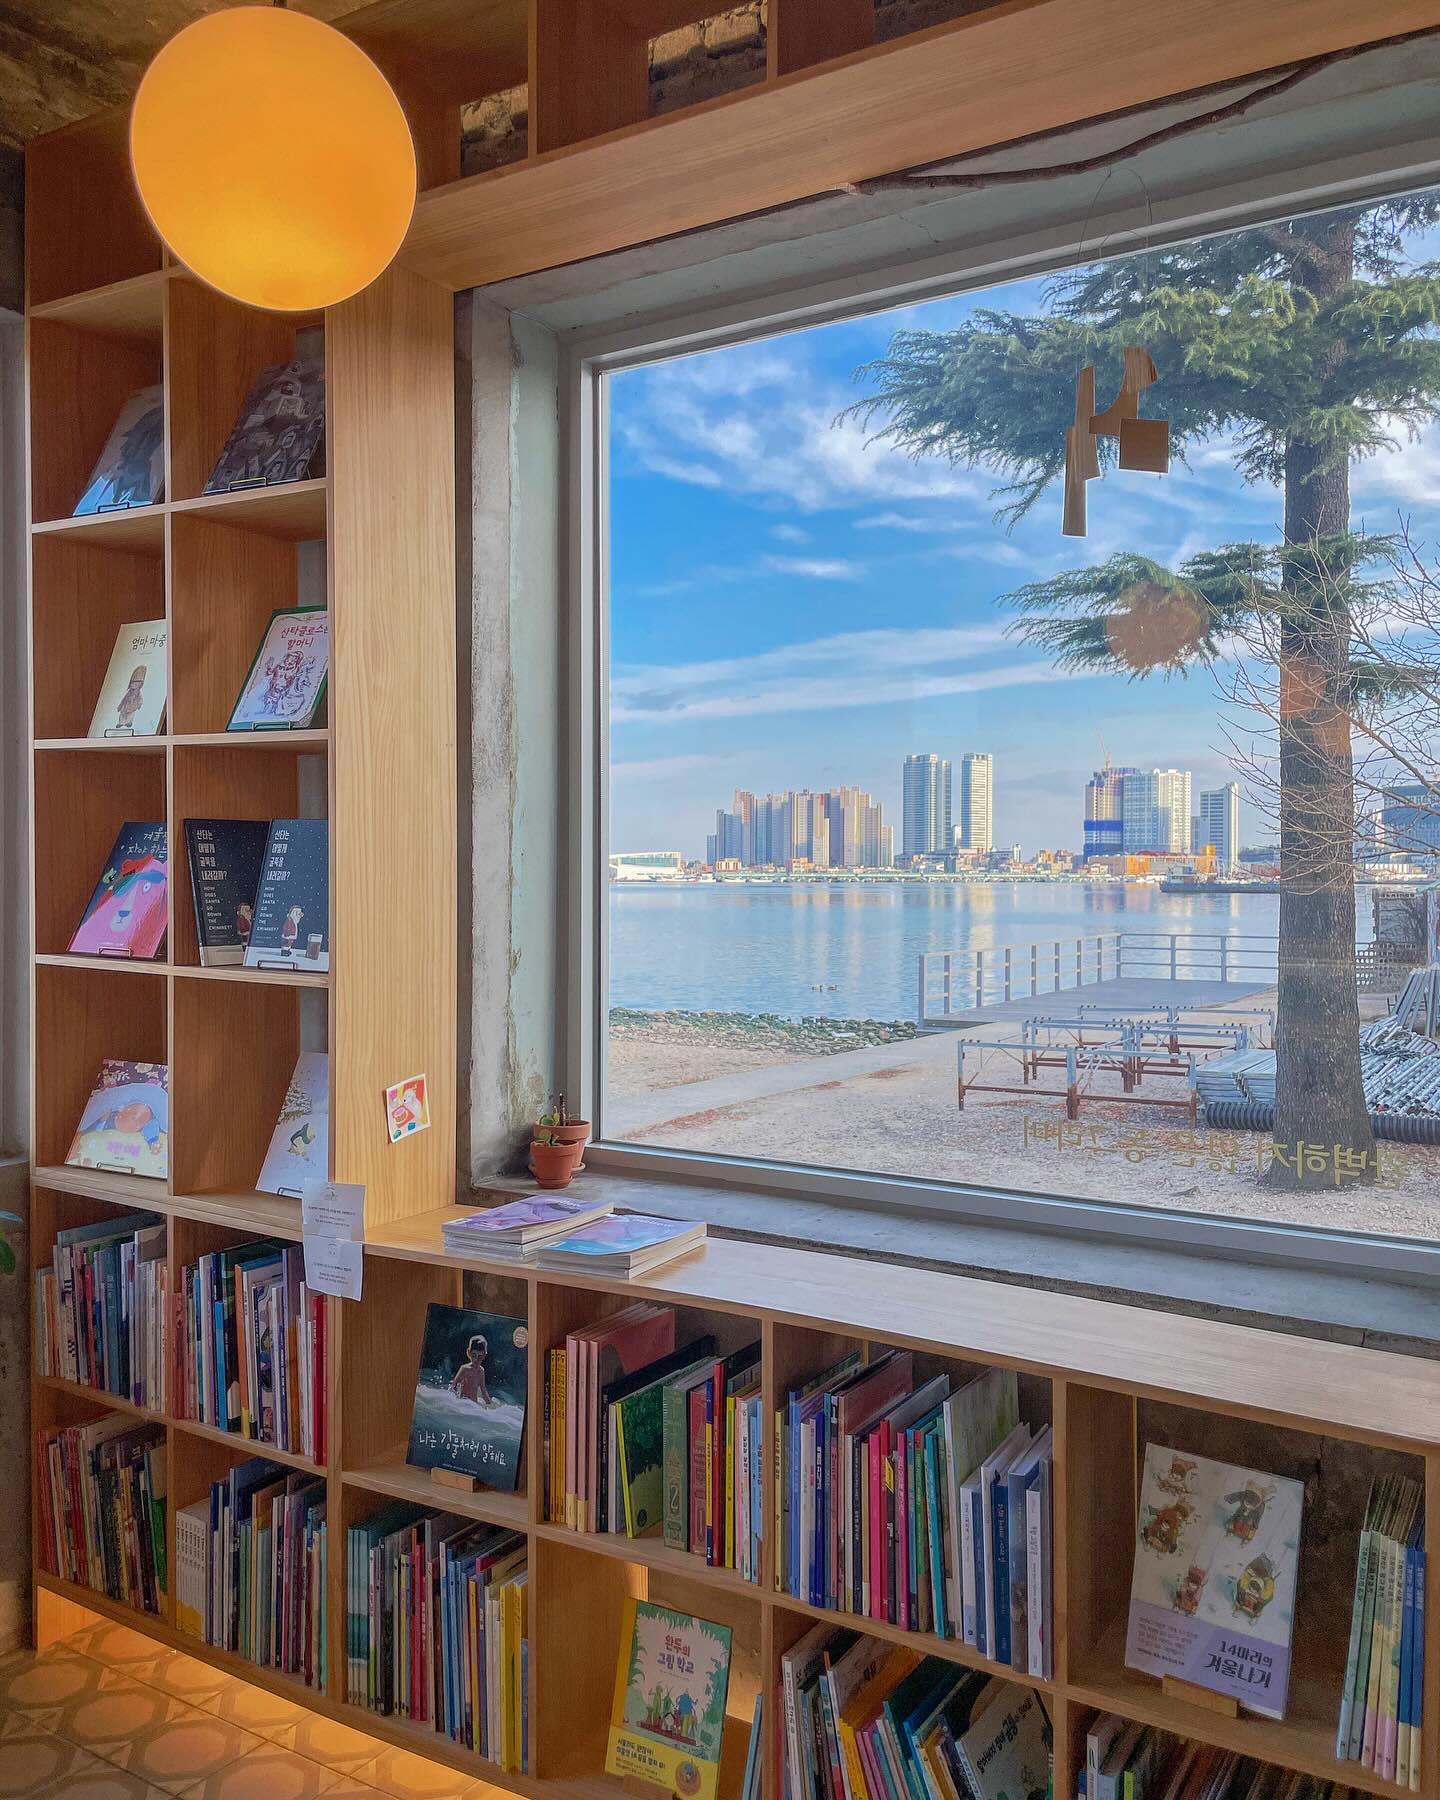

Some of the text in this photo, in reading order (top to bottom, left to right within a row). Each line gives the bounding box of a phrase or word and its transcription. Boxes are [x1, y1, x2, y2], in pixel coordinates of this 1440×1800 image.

[132, 634, 167, 650] 엄마 마중
[287, 637, 314, 651] 할머니
[127, 842, 148, 855] 자야
[419, 1429, 507, 1466] 나는 강물처럼 말해요
[664, 1634, 690, 1657] 완두의
[1220, 1641, 1272, 1668] 14마리의
[656, 1652, 695, 1674] 그림 학교
[1203, 1652, 1271, 1688] 겨울나기
